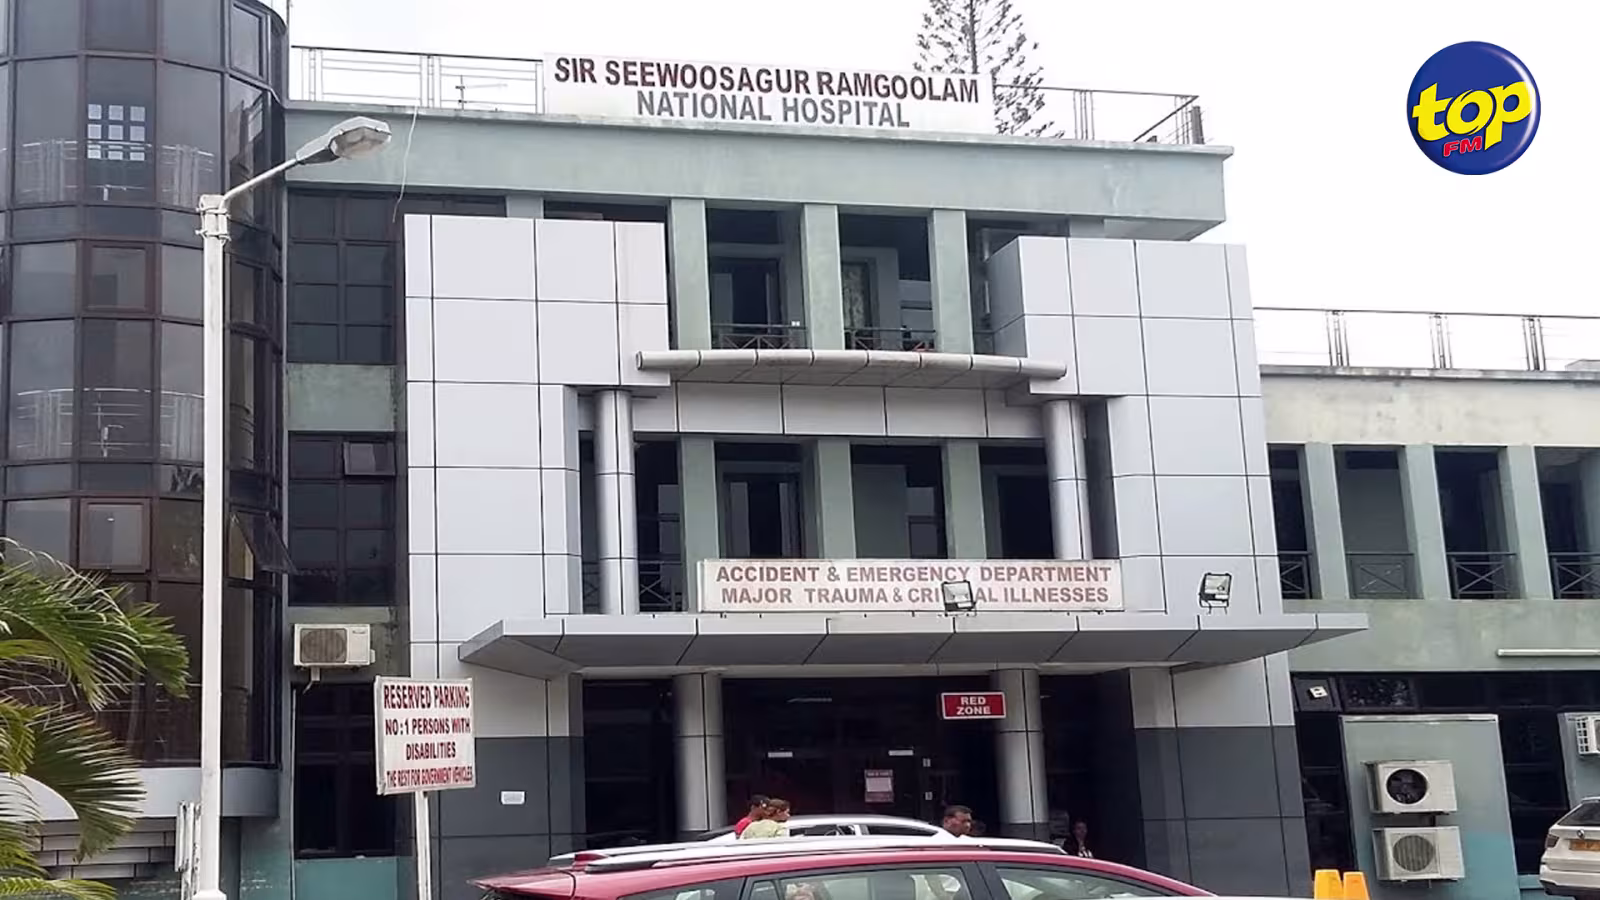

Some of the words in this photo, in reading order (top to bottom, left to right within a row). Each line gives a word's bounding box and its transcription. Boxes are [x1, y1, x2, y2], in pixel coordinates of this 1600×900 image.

[554, 56, 597, 84] SIR
[605, 60, 810, 95] SEEWOOSAGUR
[818, 71, 980, 103] RAMGOOLAM
[637, 90, 772, 121] NATIONAL
[783, 97, 910, 128] HOSPITAL
[716, 566, 820, 583] ACCIDENT
[827, 566, 840, 583] &
[847, 566, 970, 582] EMERGENCY
[980, 566, 1111, 582] DEPARTMENT
[721, 587, 792, 604] MAJOR
[804, 587, 886, 604] TRAUMA
[893, 587, 902, 603] &
[908, 587, 998, 603] CRIAL
[1004, 587, 1109, 603] ILLNESSES
[384, 685, 431, 709] RESERVED
[434, 686, 470, 708] PARKING
[961, 696, 986, 705] RED
[956, 706, 991, 715] ZONE
[412, 718, 450, 734] PERSONS
[452, 718, 471, 733] WITH
[406, 742, 456, 760] DISABILITIES
[386, 770, 397, 787] THE
[398, 769, 410, 786] REST
[411, 769, 420, 786] FOR
